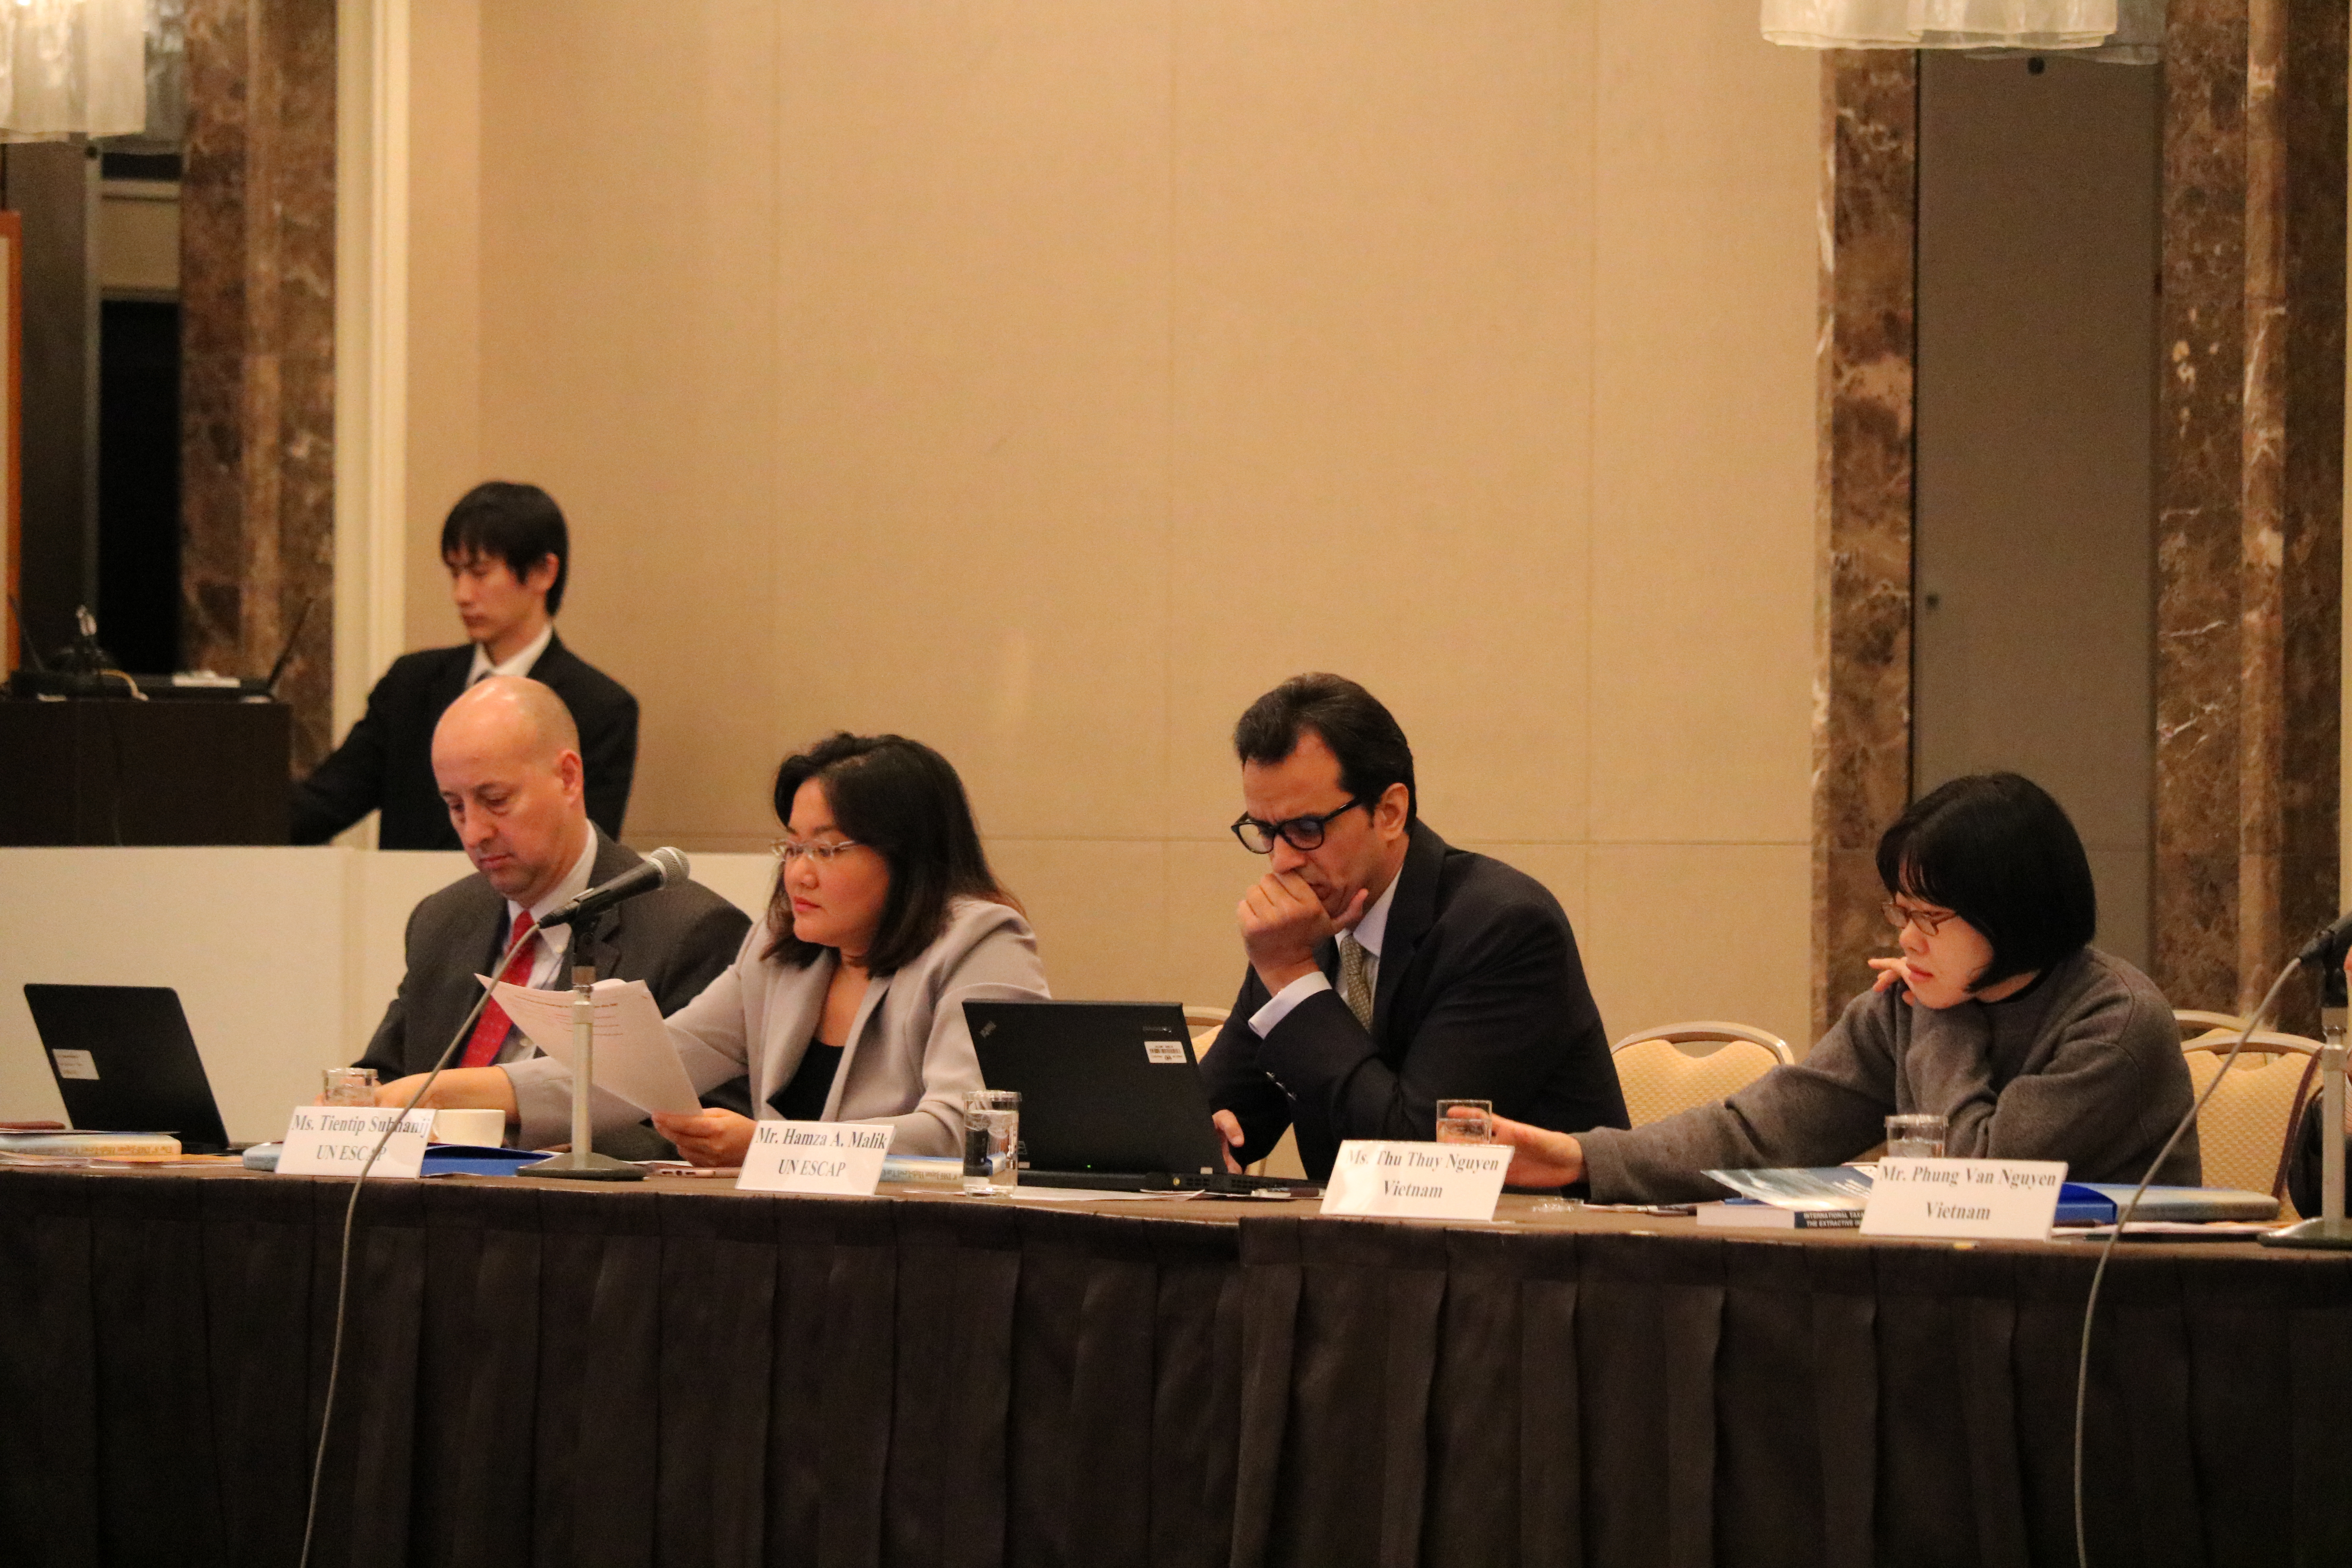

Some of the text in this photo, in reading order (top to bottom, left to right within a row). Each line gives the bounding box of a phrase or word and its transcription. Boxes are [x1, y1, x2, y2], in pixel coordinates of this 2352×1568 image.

[291, 1115, 314, 1130] Ms.
[320, 1115, 365, 1136] Tientip
[755, 1127, 888, 1149] Mr. Hamza A. Malik
[317, 1145, 338, 1160] UN
[1345, 1150, 1499, 1174] Ms. Thu Thuy Nguyen
[779, 1159, 846, 1177] UN ESCAP
[1880, 1165, 2056, 1189] Mr. Phung Van Nguyen
[1384, 1181, 1443, 1198] Vietnam
[1926, 1202, 1991, 1220] Vietnam
